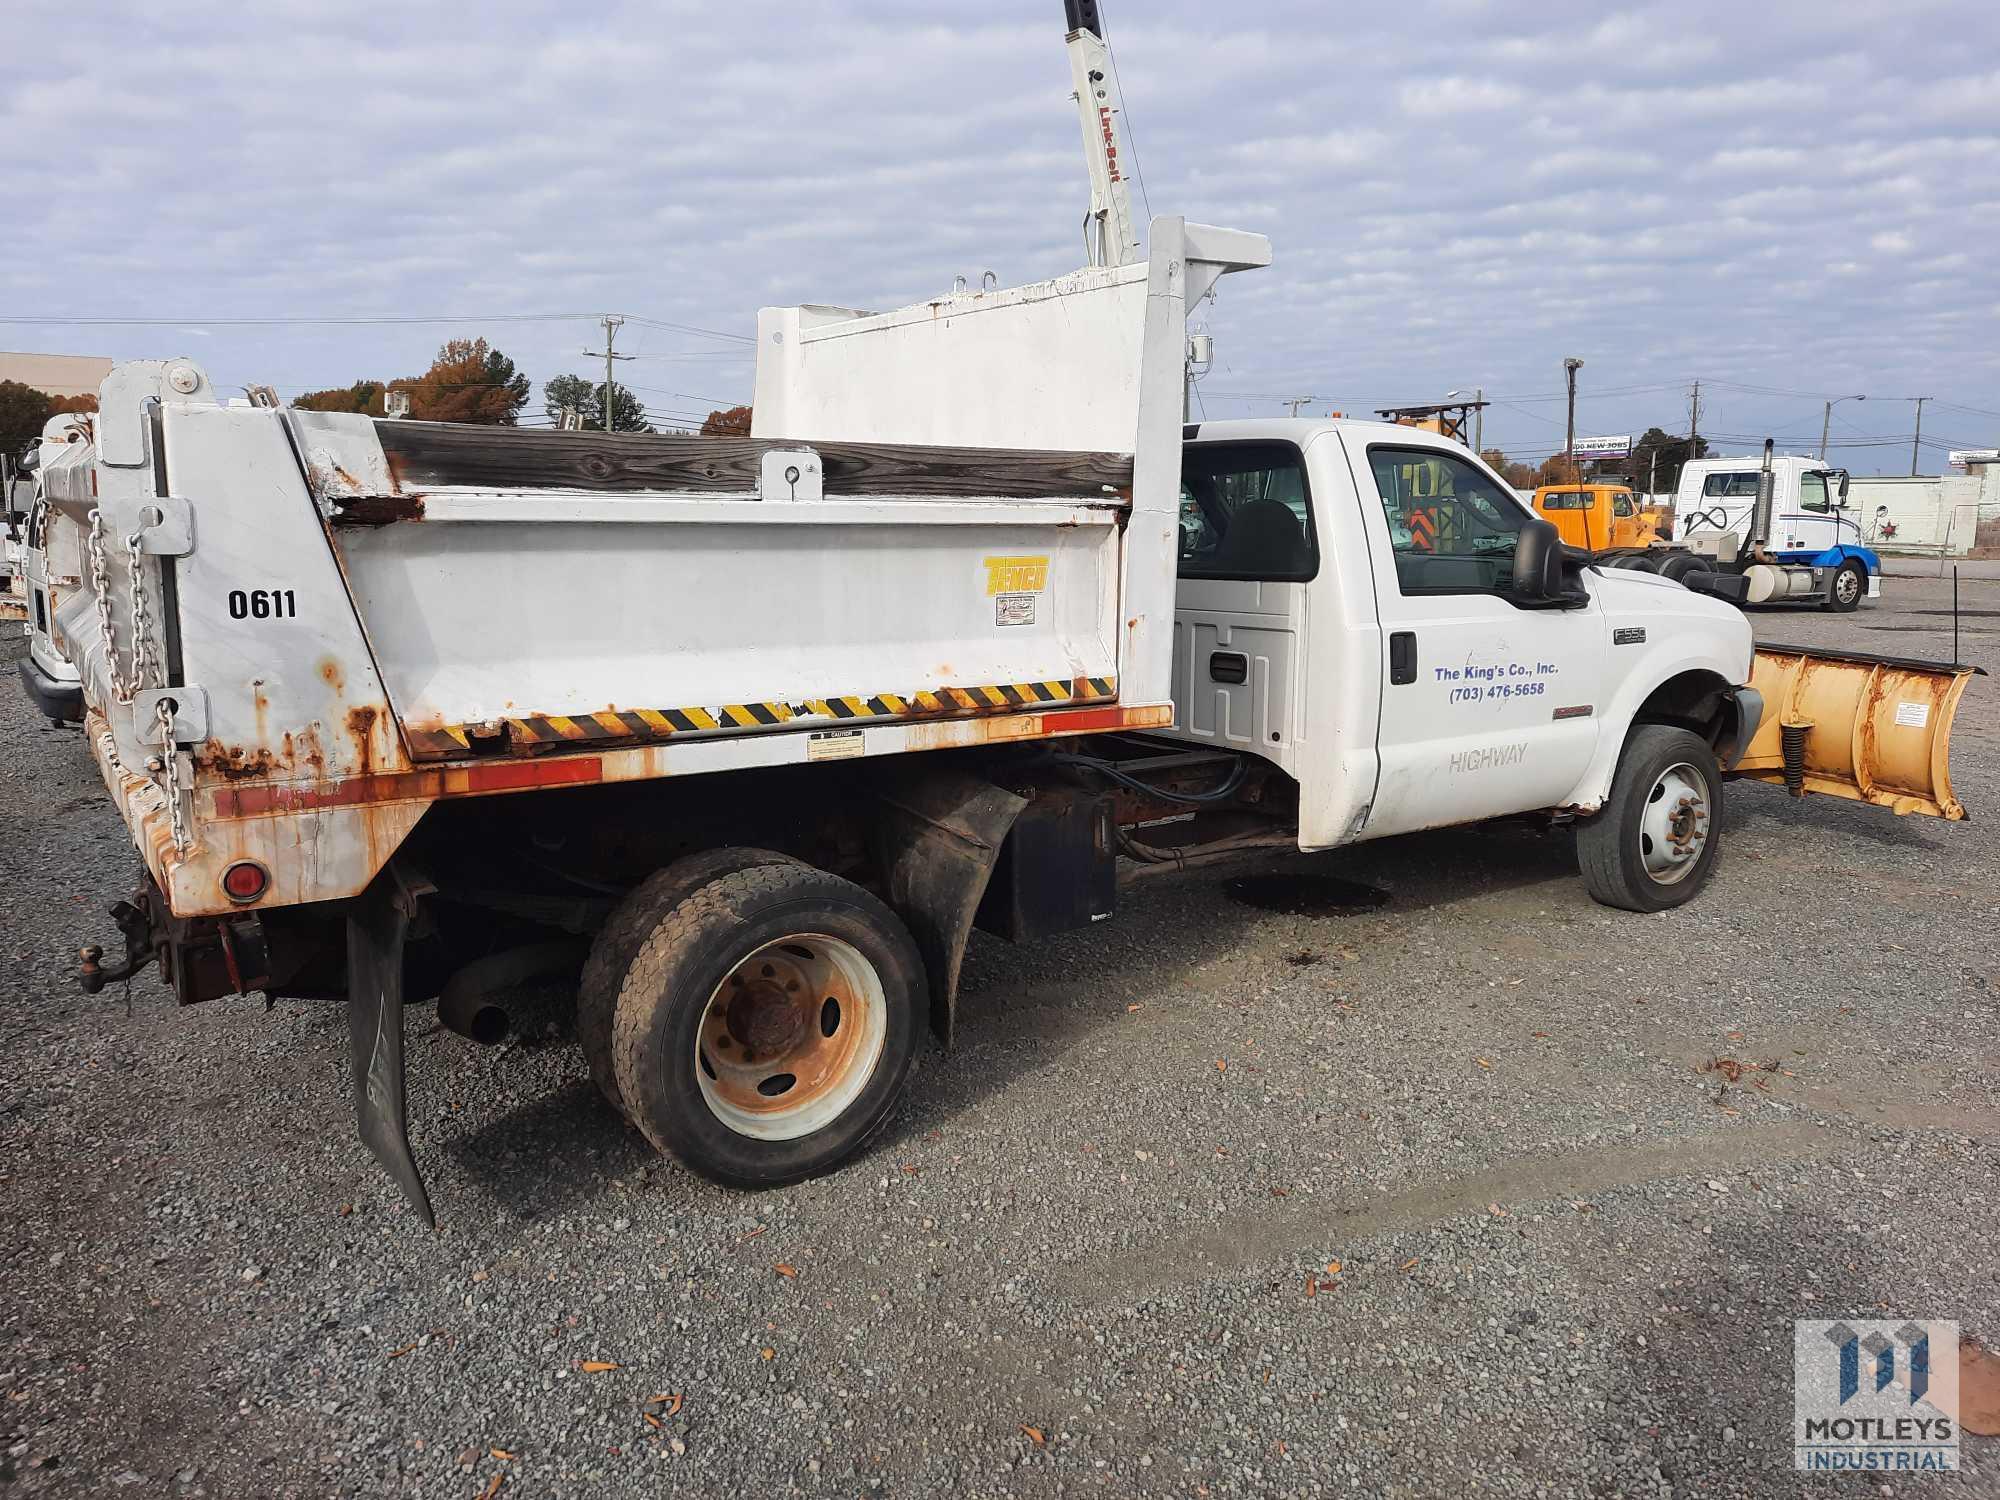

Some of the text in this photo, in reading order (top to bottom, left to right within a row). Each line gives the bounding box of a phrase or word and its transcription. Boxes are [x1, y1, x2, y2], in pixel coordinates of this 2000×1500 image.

[1100, 107, 1120, 183] Link-Belt
[228, 589, 296, 619] 0611
[1434, 662, 1559, 681] The King's Co., Inc.
[1449, 682, 1545, 704] (703) 476-5658
[1448, 742, 1529, 775] HIGHWAY
